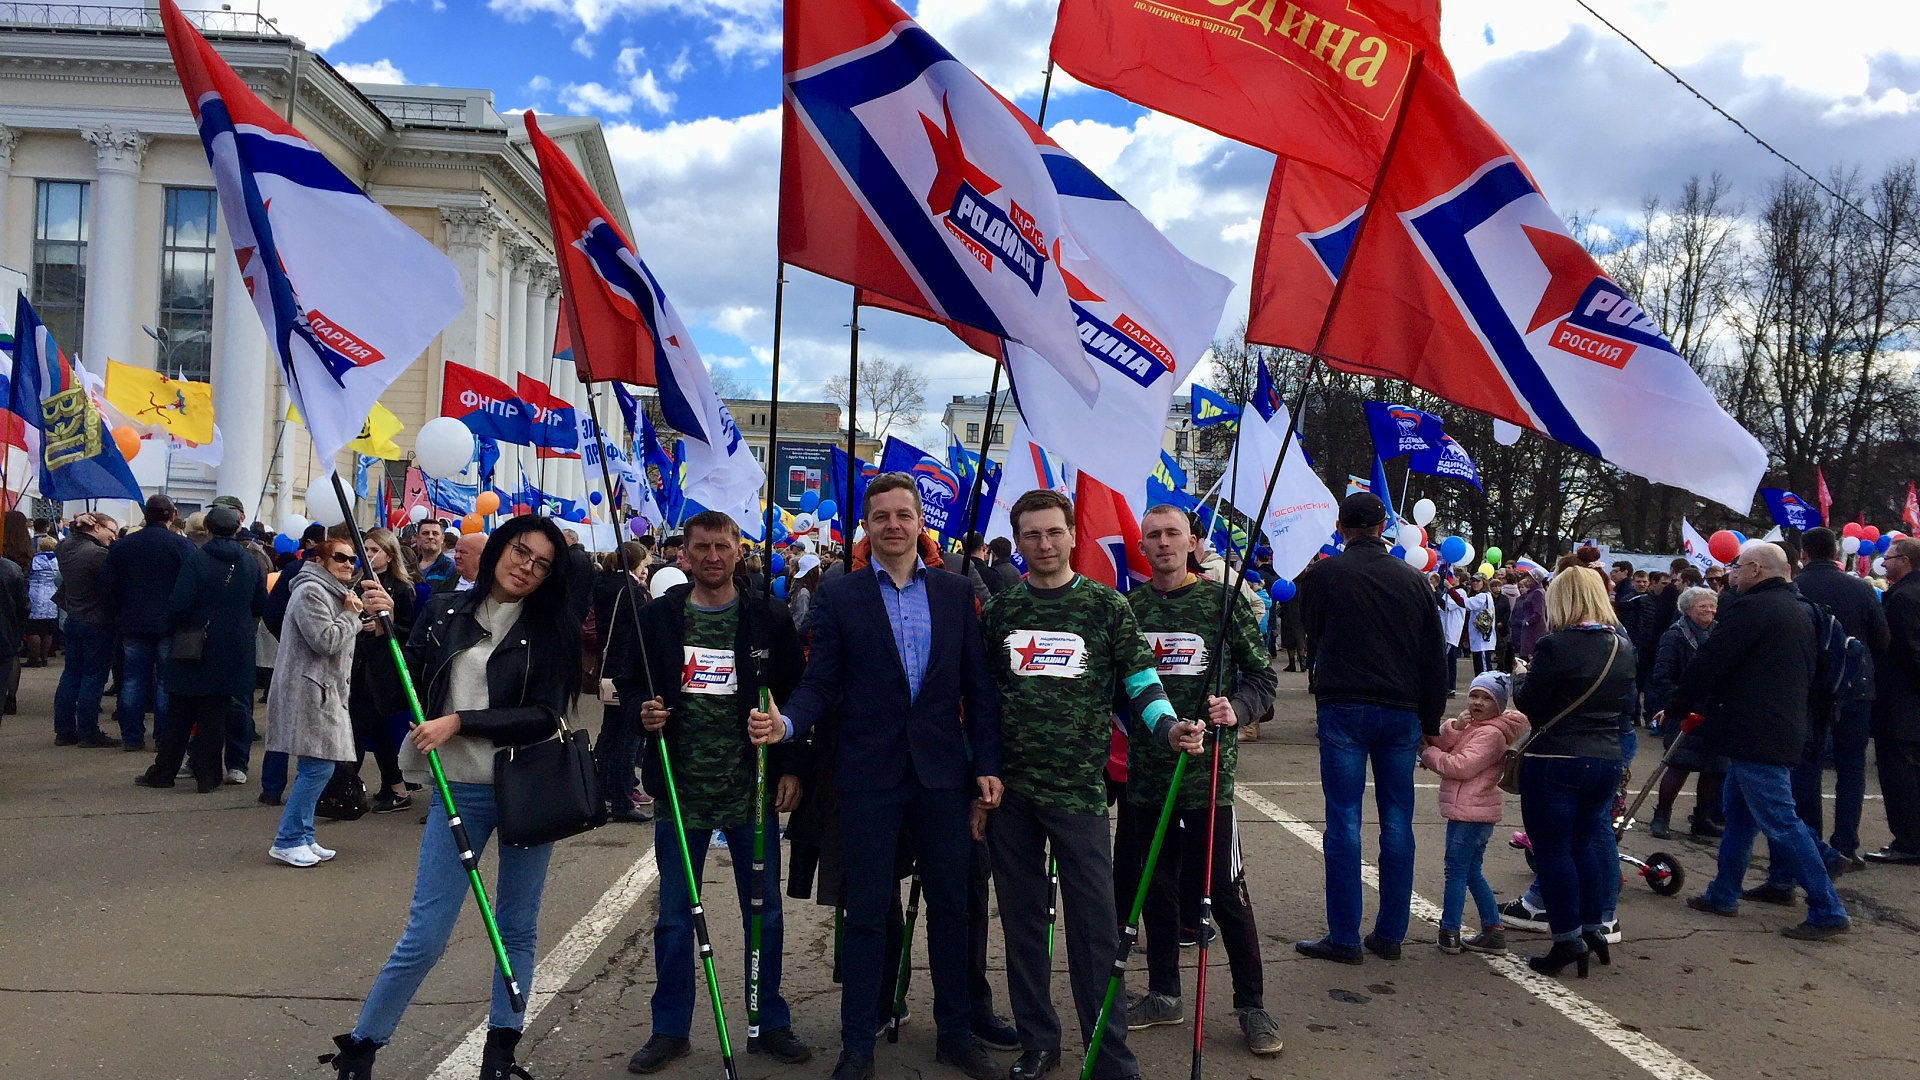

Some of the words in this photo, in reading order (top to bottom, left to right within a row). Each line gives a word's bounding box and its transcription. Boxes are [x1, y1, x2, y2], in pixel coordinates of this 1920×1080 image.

[1133, 0, 1200, 27] политическая
[1207, 0, 1388, 87] дина
[957, 194, 1036, 282] РОДИНА
[310, 317, 372, 360] ПАРТИЯ
[1073, 311, 1153, 378] ДИНА
[1122, 320, 1173, 366] ПАРТИЯ
[1559, 330, 1623, 361] РОССИЯ
[460, 389, 519, 419] ФНПР
[1436, 466, 1473, 480] РОССИЯ
[1437, 460, 1473, 475] ЕДИНАЯ
[1033, 655, 1067, 664] РОДИНА
[1161, 656, 1189, 664] РОДИНА
[694, 673, 726, 682] РОДИНА
[751, 949, 760, 981] Tele
[750, 984, 759, 1012] rod
